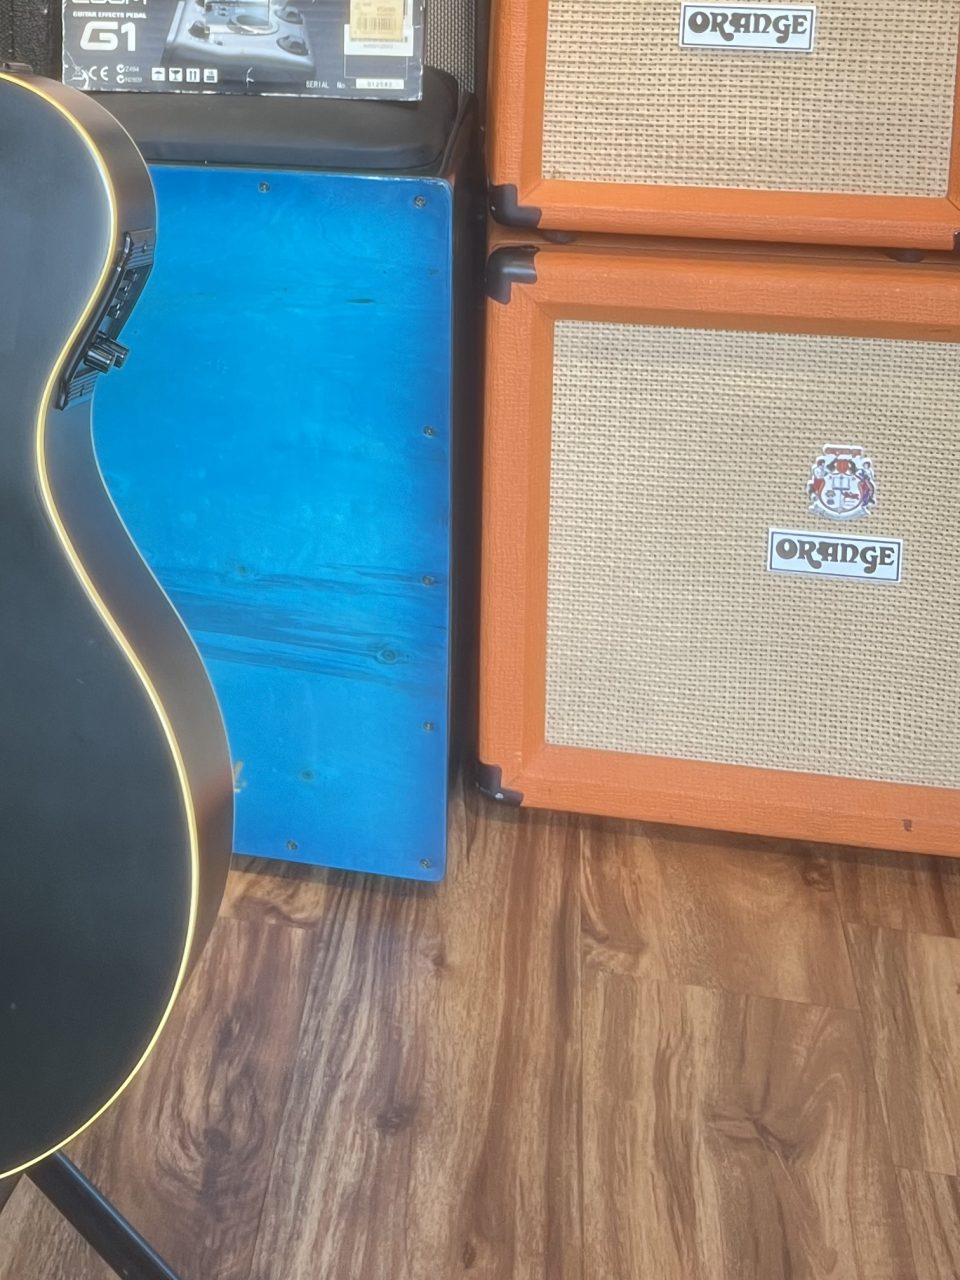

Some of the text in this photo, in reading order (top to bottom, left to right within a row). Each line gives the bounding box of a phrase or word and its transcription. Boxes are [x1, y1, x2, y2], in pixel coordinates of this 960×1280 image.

[72, 10, 97, 18] GUITAR
[688, 10, 808, 44] ORANGE
[79, 21, 137, 52] G1
[305, 80, 330, 89] SERIAL
[775, 538, 895, 574] ORANGE
